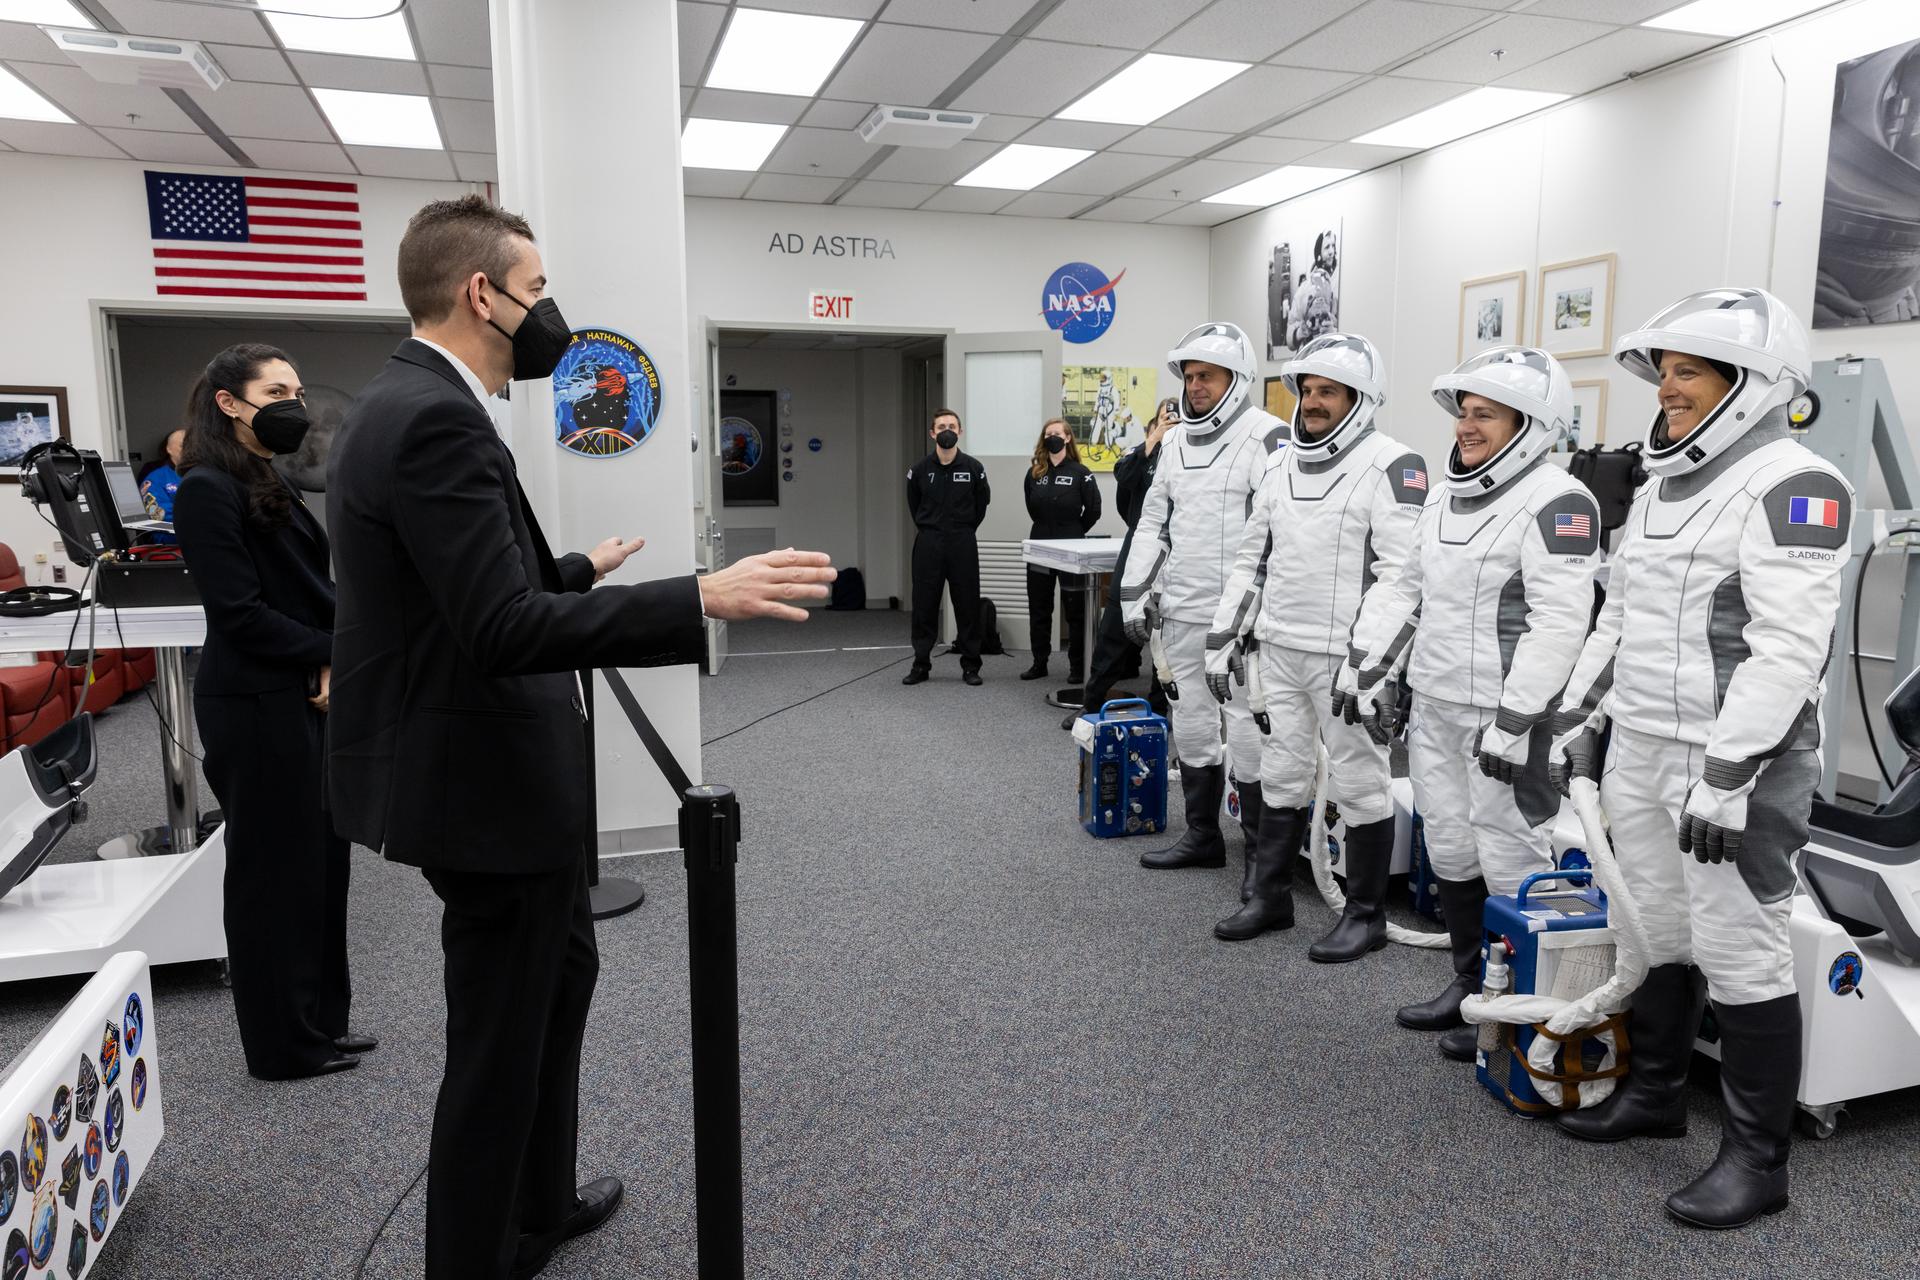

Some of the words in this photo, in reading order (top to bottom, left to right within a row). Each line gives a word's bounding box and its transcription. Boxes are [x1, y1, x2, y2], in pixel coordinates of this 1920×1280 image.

[768, 232, 804, 254] AD
[812, 235, 896, 260] ASTRA
[813, 295, 854, 318] EXIT
[1048, 293, 1112, 312] NASA
[586, 332, 636, 353] HATHAWAY
[928, 472, 935, 484] 7
[1787, 550, 1837, 561] S.ADENOT
